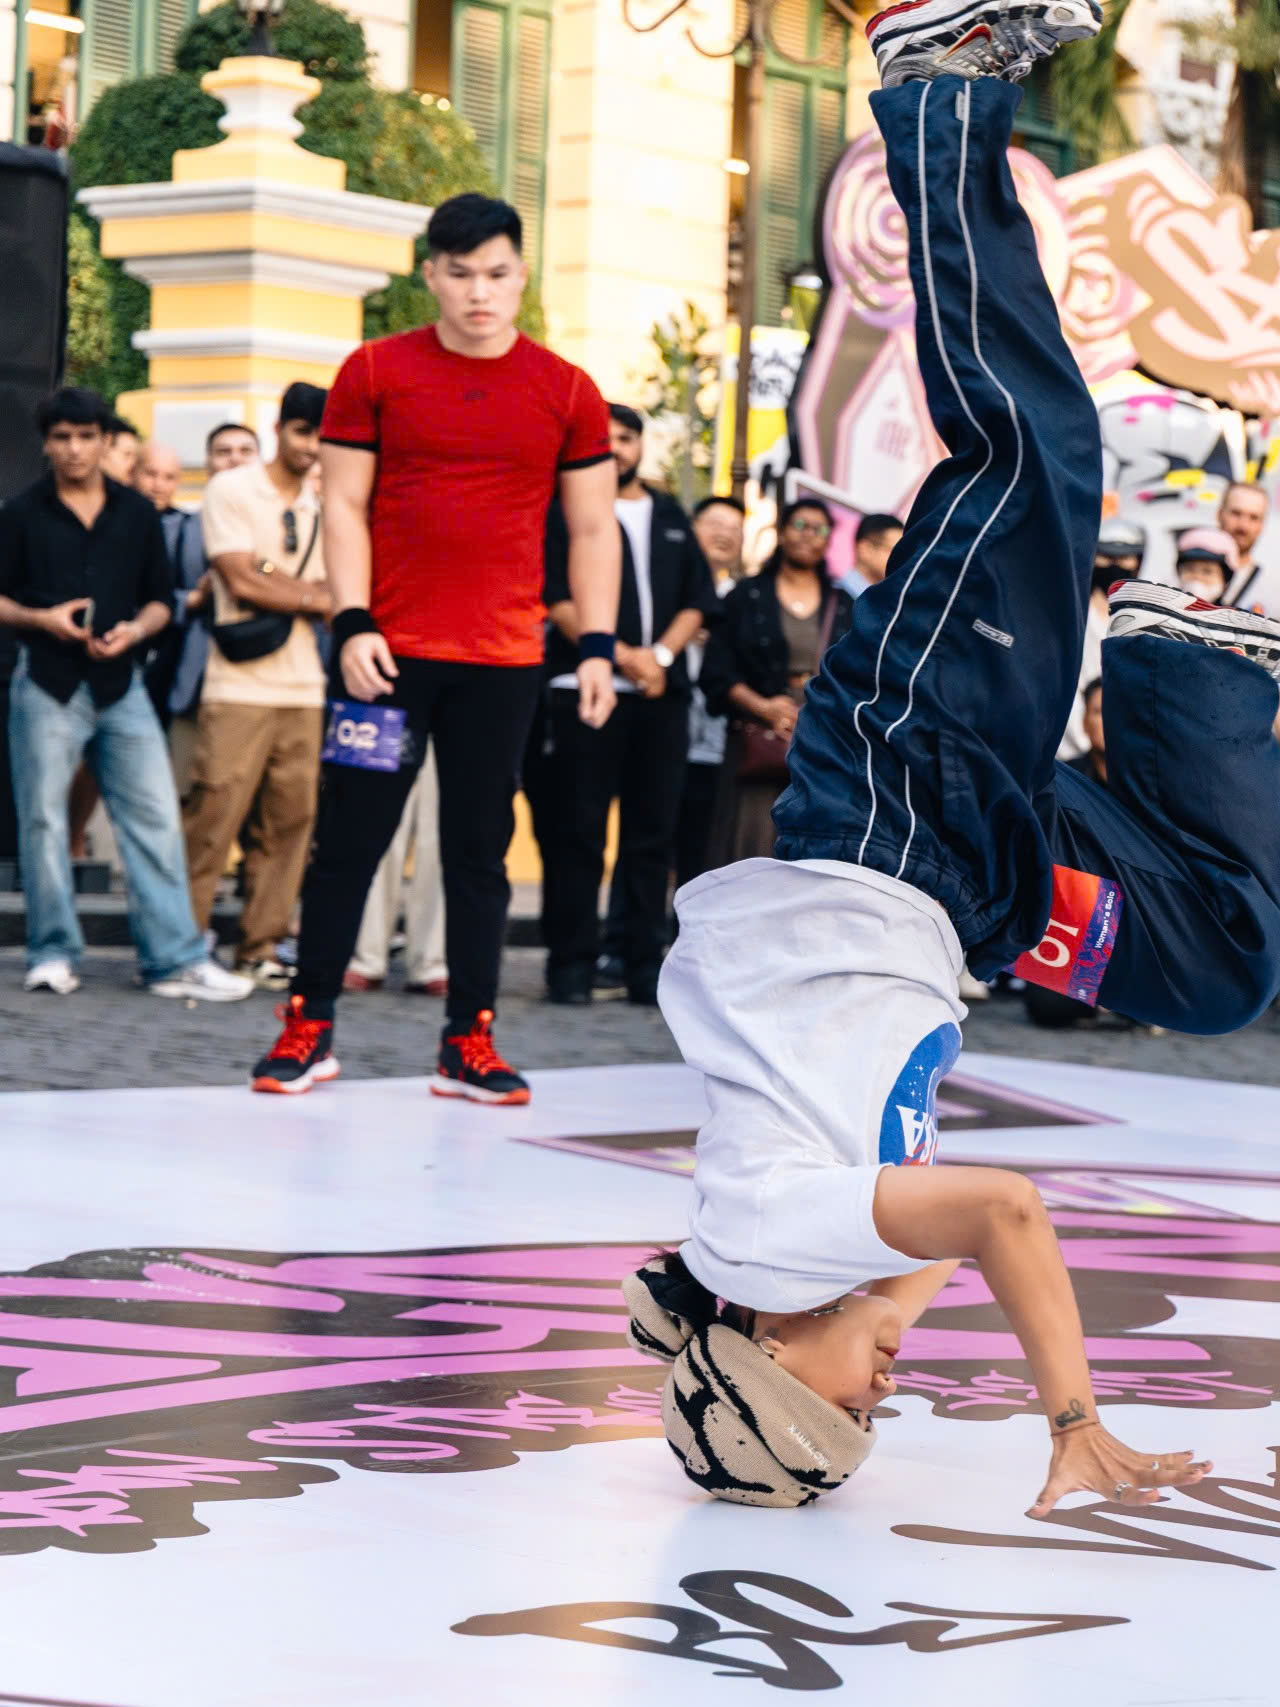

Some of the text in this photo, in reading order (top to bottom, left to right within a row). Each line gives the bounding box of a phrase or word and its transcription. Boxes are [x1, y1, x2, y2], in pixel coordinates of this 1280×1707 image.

[337, 719, 379, 750] 02
[1095, 890, 1115, 948] Woman's Solo
